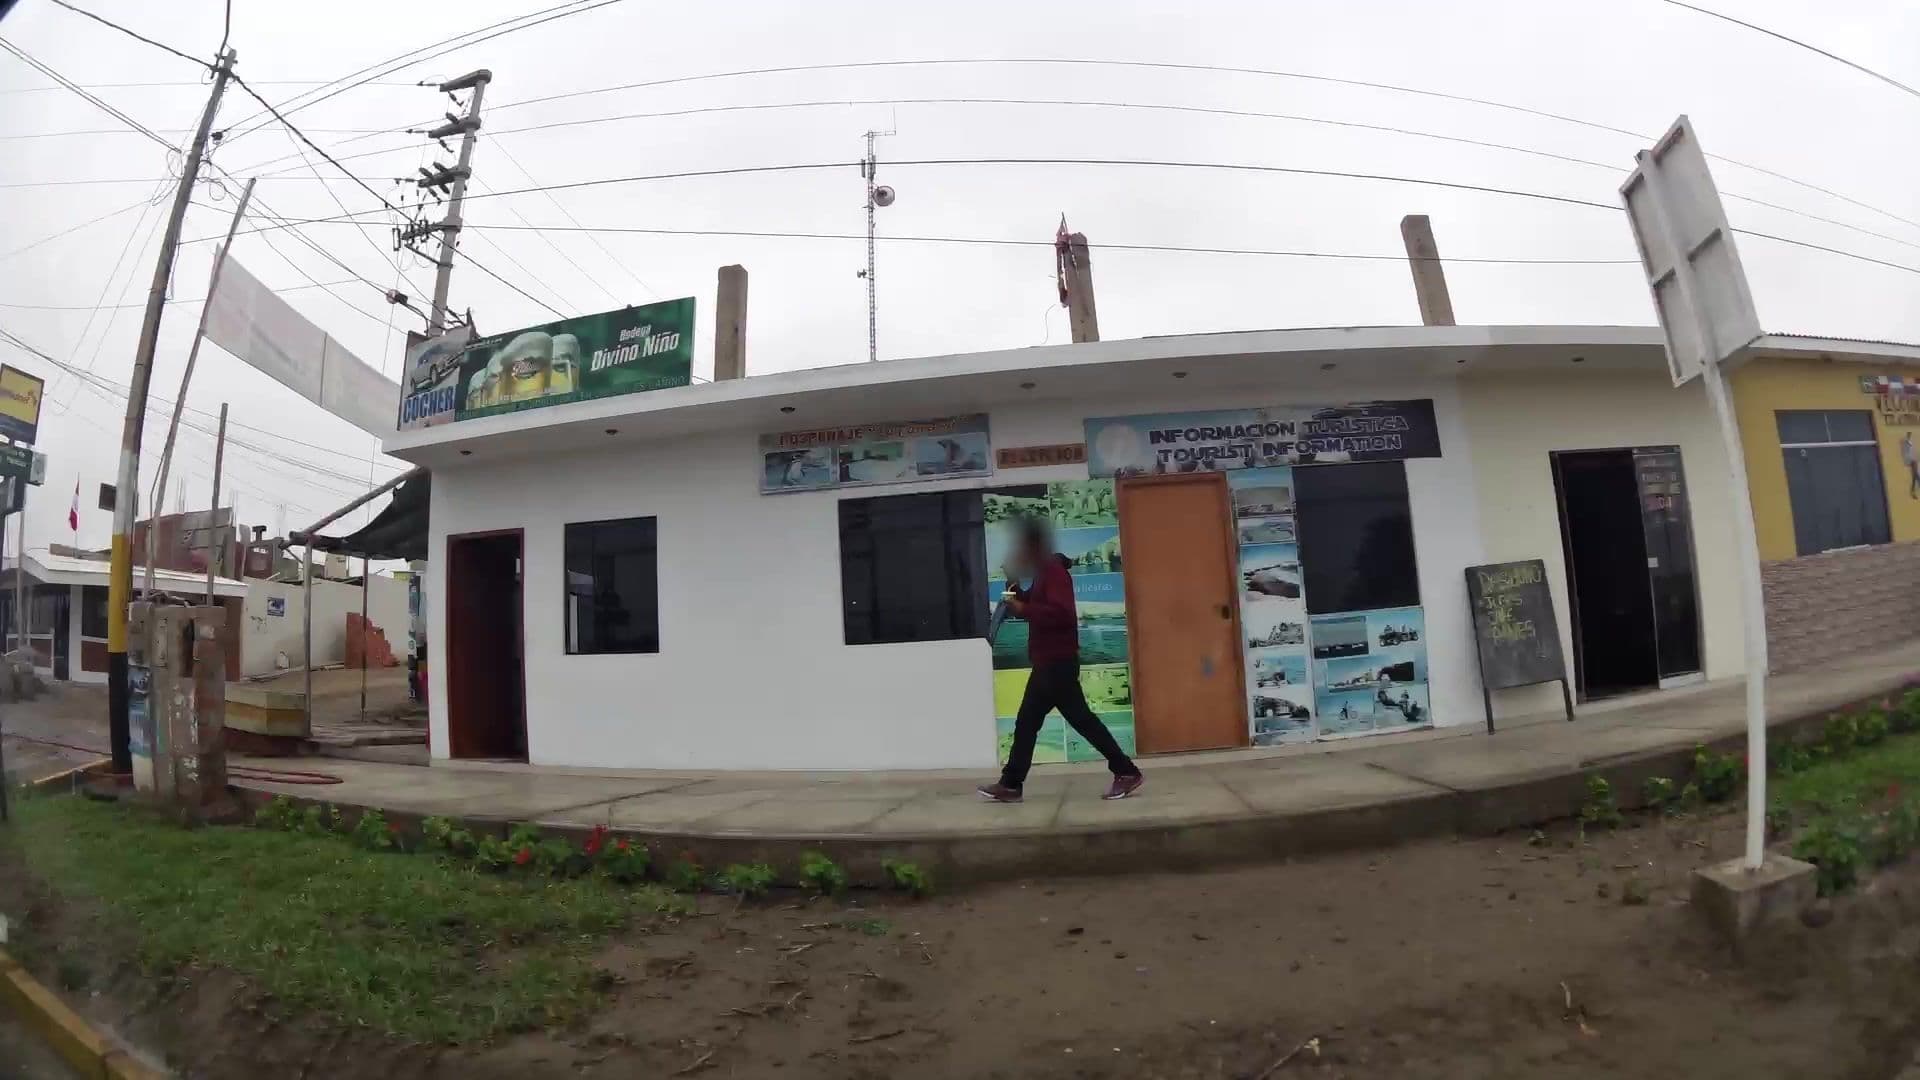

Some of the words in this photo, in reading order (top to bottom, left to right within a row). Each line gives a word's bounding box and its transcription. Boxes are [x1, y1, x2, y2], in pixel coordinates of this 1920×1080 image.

[619, 324, 652, 342] Bodega
[590, 343, 640, 372] Divino
[642, 330, 681, 358] Niño
[1157, 444, 1253, 463] TOURIST
[1262, 434, 1402, 457] INFORMATION
